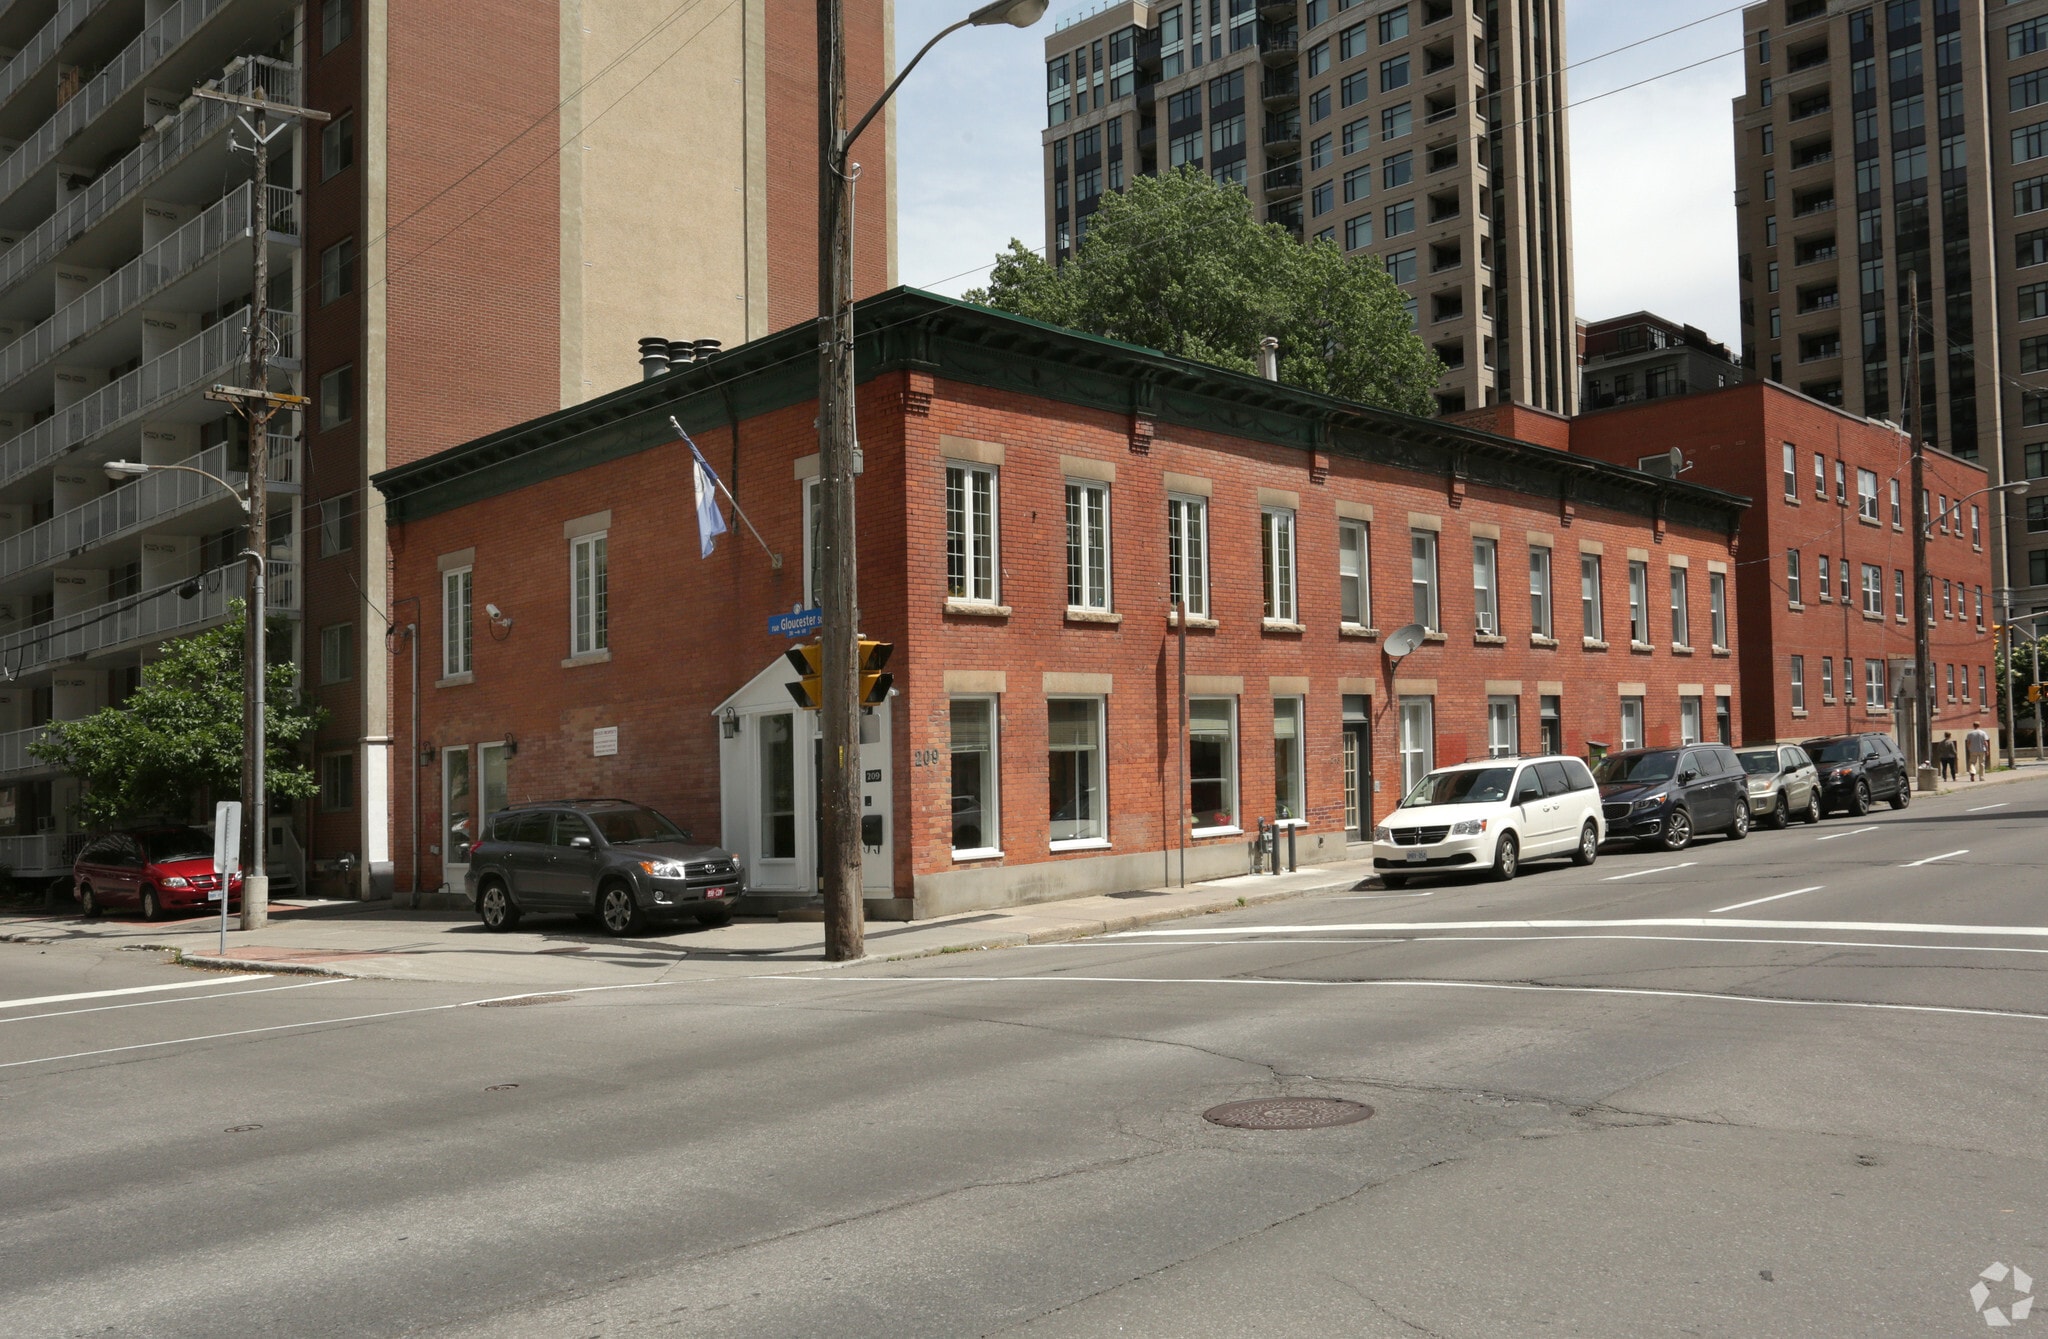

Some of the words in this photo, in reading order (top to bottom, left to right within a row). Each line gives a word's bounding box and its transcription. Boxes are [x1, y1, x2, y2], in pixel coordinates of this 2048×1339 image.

[780, 615, 816, 631] Gloucester
[914, 748, 939, 767] 209
[866, 771, 880, 780] 209
